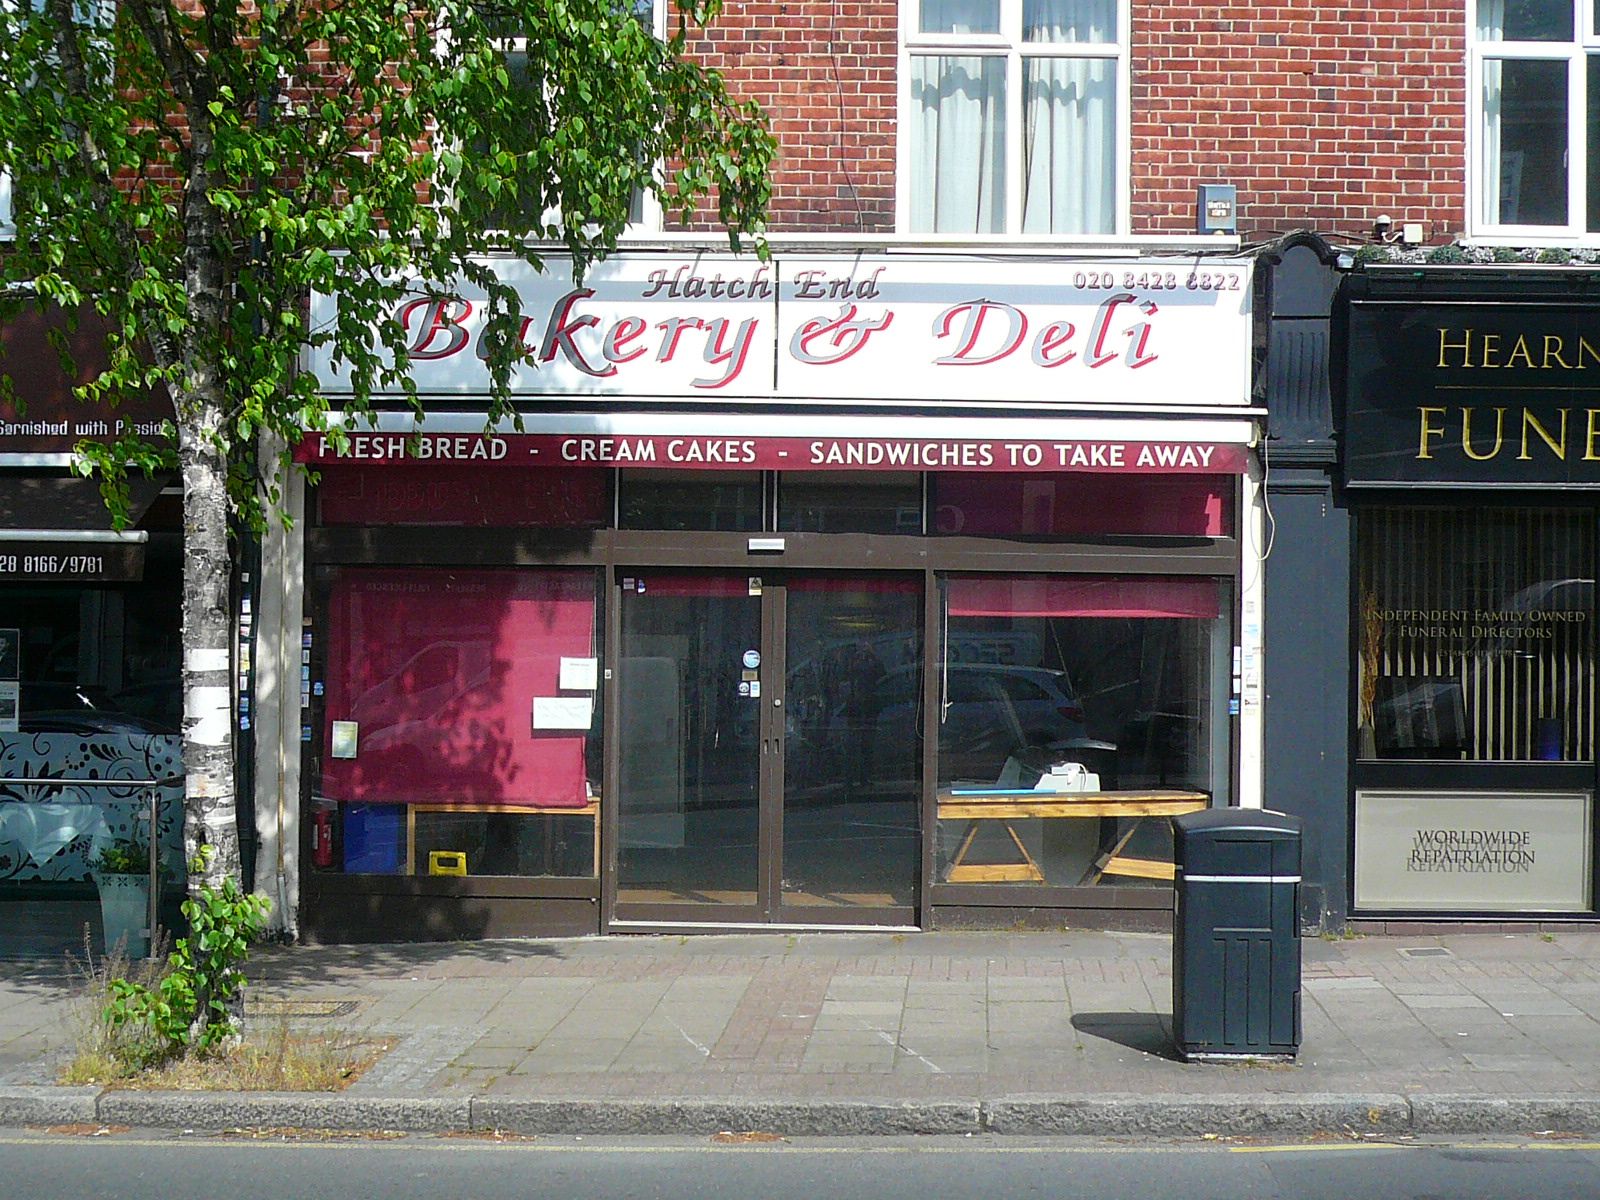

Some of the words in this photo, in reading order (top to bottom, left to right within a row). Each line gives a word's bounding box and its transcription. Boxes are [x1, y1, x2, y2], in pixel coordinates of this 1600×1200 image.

[642, 264, 773, 299] Hatch
[793, 265, 887, 299] End
[1072, 271, 1114, 290] 020
[1122, 271, 1177, 290] 8428
[1185, 271, 1240, 291] 8822
[789, 302, 894, 365] &
[931, 293, 1159, 369] Deli
[1437, 329, 1600, 369] HEARN
[75, 420, 108, 436] with
[115, 419, 172, 437] Pssio
[1415, 407, 1600, 461] FUNE
[418, 437, 507, 460] BREAD
[562, 438, 656, 462] CREAM
[668, 439, 757, 462] CAKES
[810, 441, 993, 467] SANDWICHES
[1004, 444, 1042, 467] TO
[1053, 444, 1125, 467] TAKE
[1136, 445, 1215, 467] AWAY
[24, 555, 103, 573] 8166/9781
[1367, 609, 1467, 622] INDEPENDENT
[1475, 609, 1525, 622] FAMILY
[1529, 610, 1586, 623] OWNED
[1400, 625, 1464, 638] FUNERAL
[1471, 625, 1552, 639] DIRECTORS
[1417, 829, 1530, 846] WORLDWIDE
[1411, 849, 1535, 865] REPATRIATION
